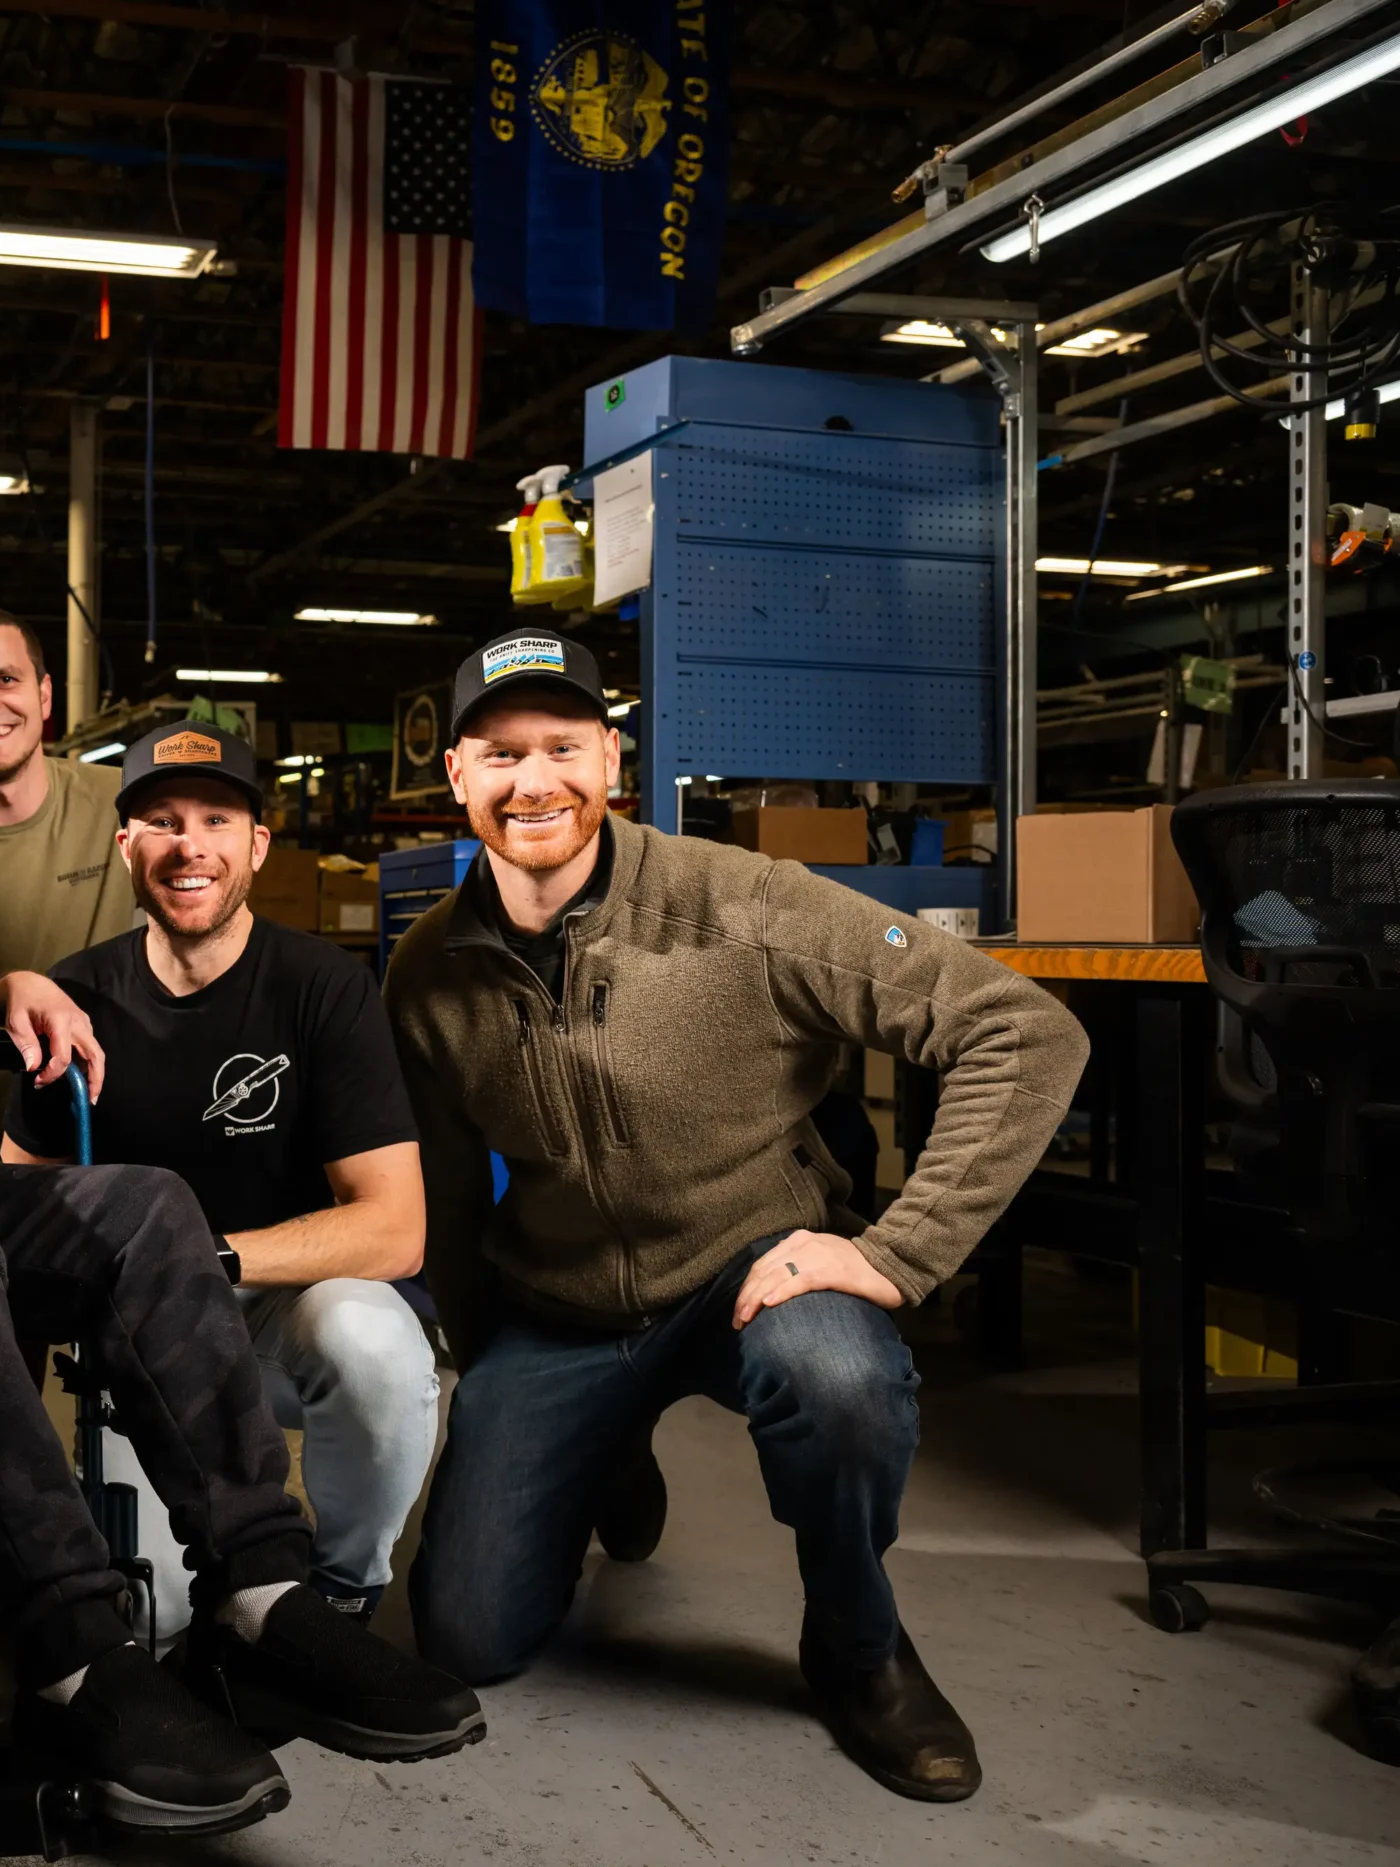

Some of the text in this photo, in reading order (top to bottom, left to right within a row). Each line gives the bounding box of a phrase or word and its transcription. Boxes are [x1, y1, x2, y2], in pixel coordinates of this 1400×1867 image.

[489, 39, 519, 143] 1859
[682, 76, 710, 124] OF
[660, 133, 704, 280] OREGON
[487, 640, 557, 659] WORK SHARP
[158, 740, 216, 755] Work Sharp
[234, 1126, 255, 1134] WORK
